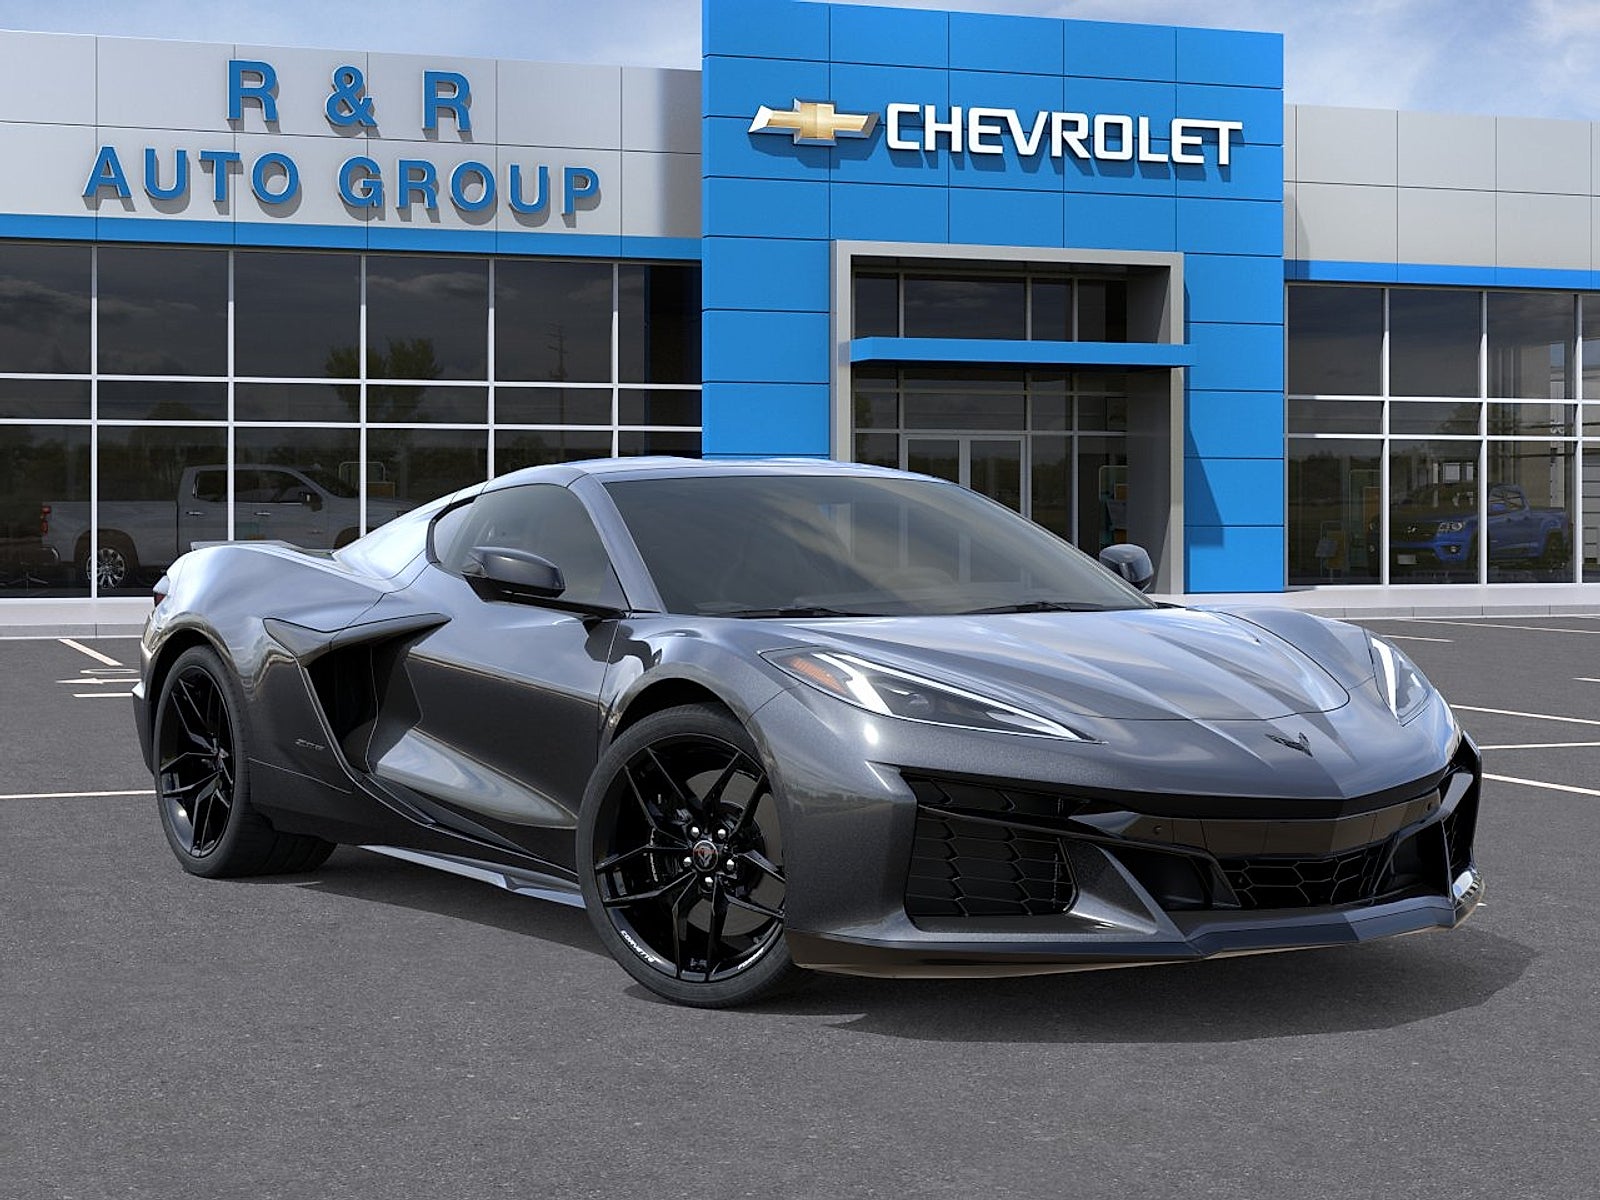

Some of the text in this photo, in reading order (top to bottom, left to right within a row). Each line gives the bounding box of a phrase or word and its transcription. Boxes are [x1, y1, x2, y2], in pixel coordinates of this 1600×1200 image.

[227, 60, 472, 132] R & R
[886, 103, 1243, 165] CHEVROLET
[82, 146, 601, 214] AUTO GROUP
